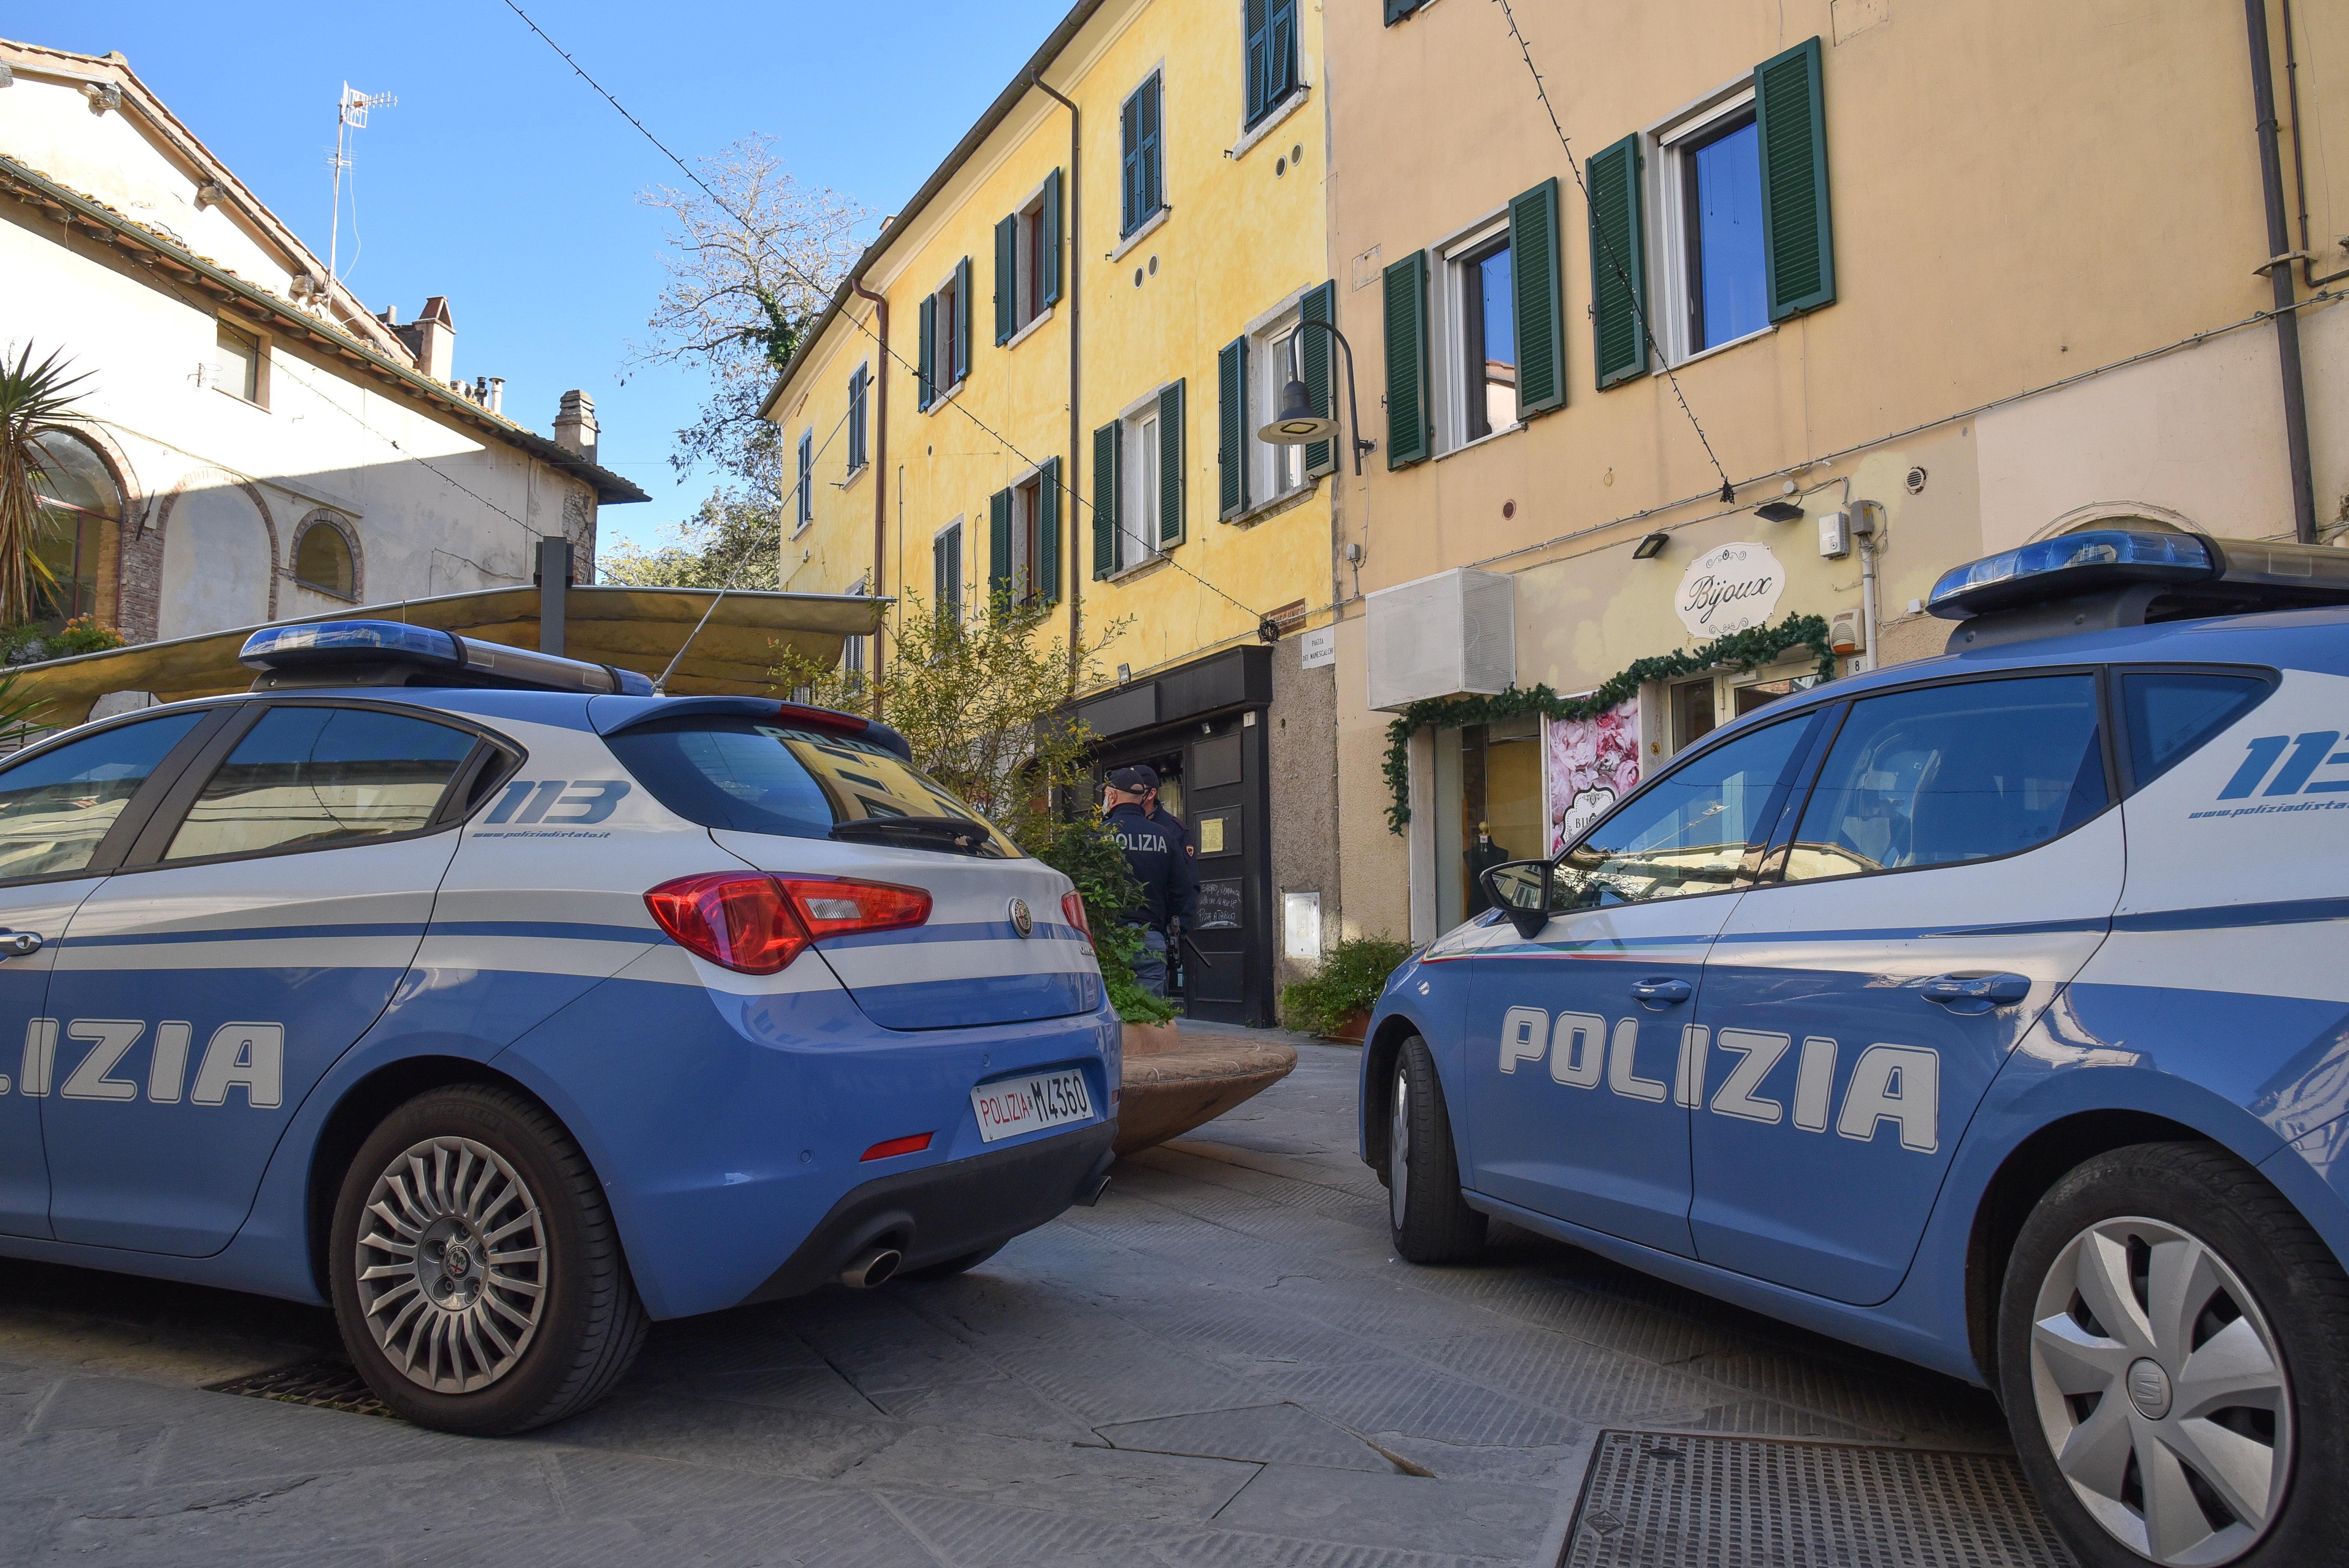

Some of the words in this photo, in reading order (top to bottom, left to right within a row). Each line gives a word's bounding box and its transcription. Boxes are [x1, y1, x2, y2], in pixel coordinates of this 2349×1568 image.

[1685, 575, 1772, 624] Bijoux
[1288, 607, 1304, 623] UNICO
[1312, 638, 1323, 646] PIAZZA
[1310, 648, 1333, 660] MANESCALCHI
[1855, 660, 1860, 671] 8
[1247, 715, 1250, 724] 7
[483, 780, 631, 824] 113
[2188, 800, 2349, 819] www.poliziadista
[472, 831, 612, 839] www.poliziadistato.it
[0, 1018, 284, 1109] IZIA
[1499, 1005, 1939, 1154] POLIZIA
[980, 1092, 1030, 1127] POLIZIA
[1030, 1075, 1087, 1122] M4360
